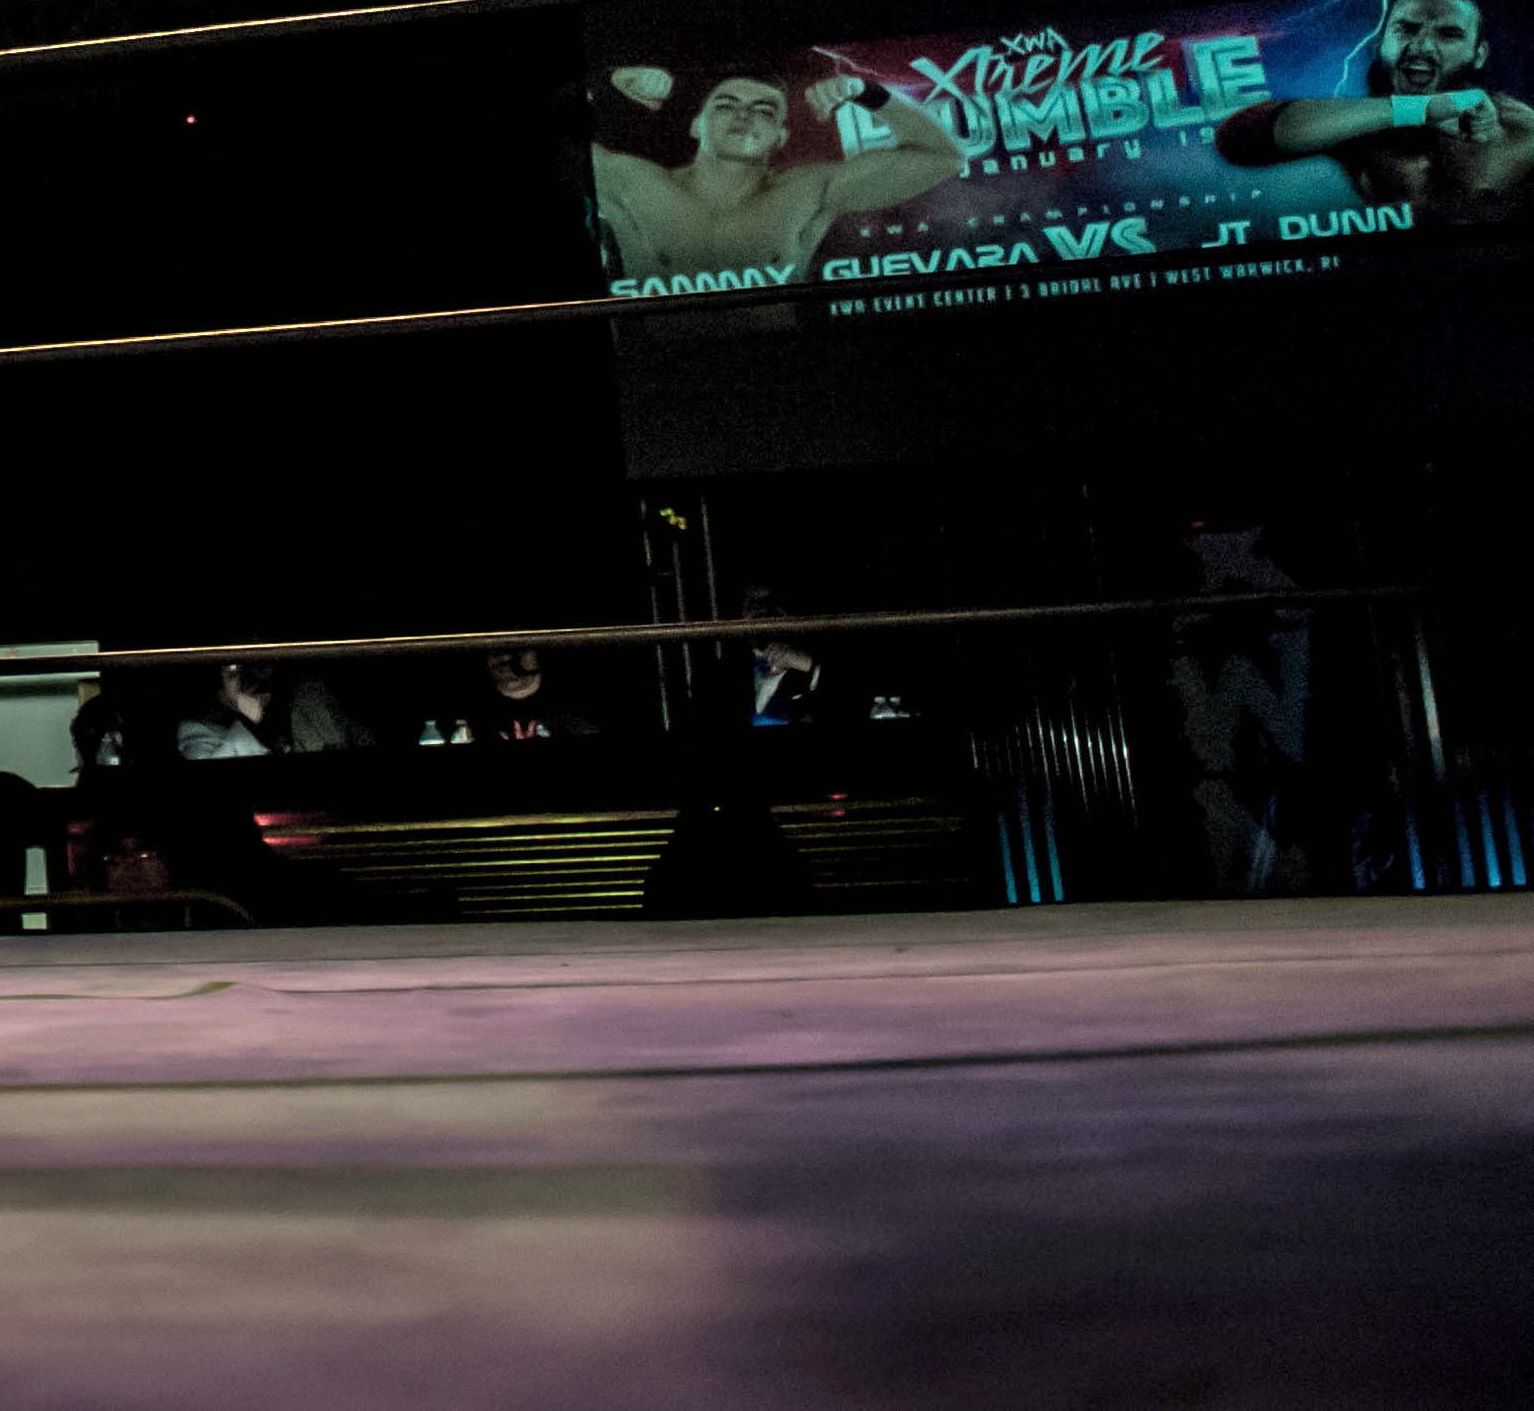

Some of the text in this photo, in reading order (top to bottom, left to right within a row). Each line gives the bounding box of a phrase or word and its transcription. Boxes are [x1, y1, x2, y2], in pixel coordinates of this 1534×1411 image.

[1000, 26, 1069, 57] XWA
[910, 31, 1165, 105] Xtreme
[610, 202, 1413, 298] SAMMY GUEVARA VS JT DUNN
[1165, 265, 1211, 285] WEST
